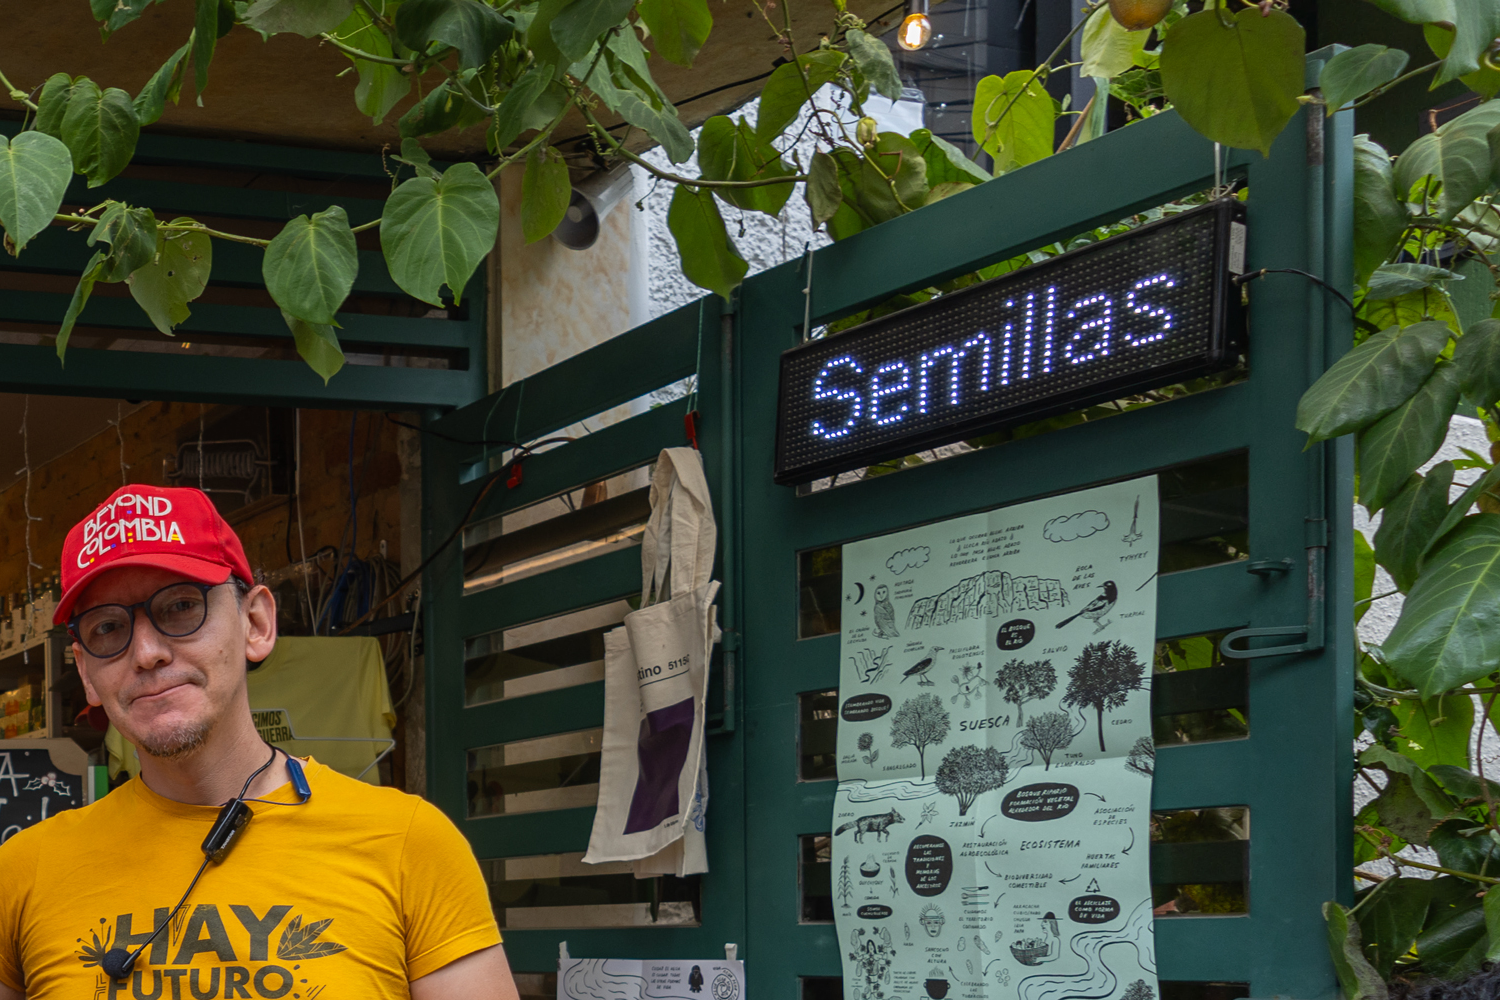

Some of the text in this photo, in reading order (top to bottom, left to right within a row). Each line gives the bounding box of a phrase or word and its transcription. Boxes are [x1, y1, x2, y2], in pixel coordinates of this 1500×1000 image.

[811, 272, 1176, 440] Semillas
[83, 493, 172, 544] BEYOND
[77, 518, 186, 569] COLOMBIA
[1042, 645, 1068, 654] SALVIO
[959, 715, 1010, 732] SUESCA
[1094, 804, 1135, 814] ASOCIACIÓN
[1020, 839, 1080, 850] ECOSISTEMA
[112, 903, 294, 965] HAY
